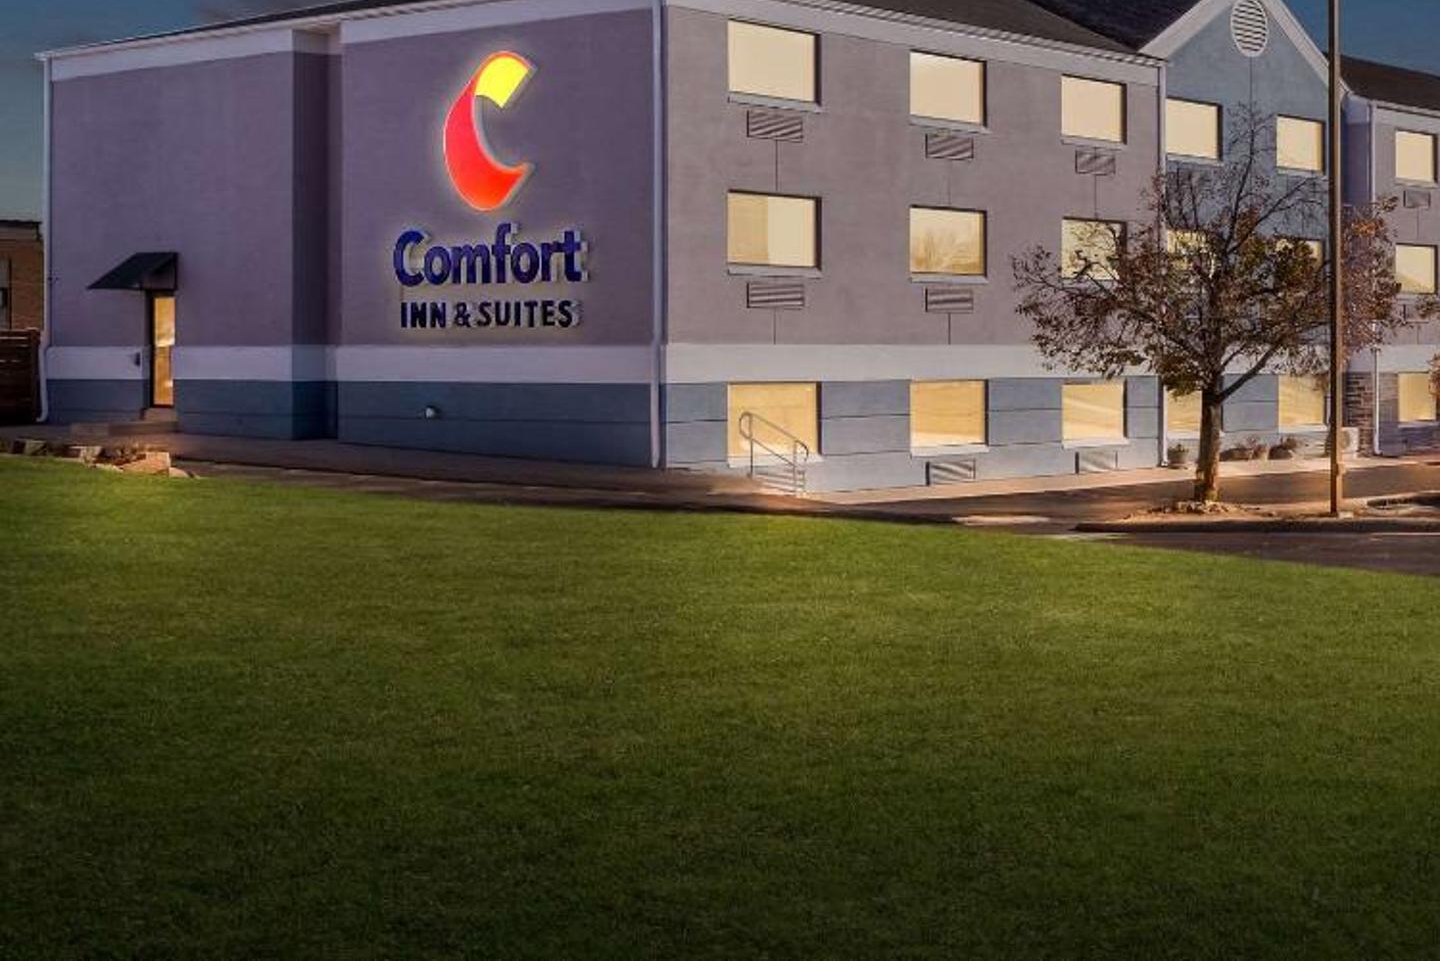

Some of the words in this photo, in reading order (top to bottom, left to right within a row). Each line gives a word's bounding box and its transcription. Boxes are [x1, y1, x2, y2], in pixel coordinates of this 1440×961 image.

[393, 222, 585, 287] Comfort
[400, 301, 447, 328] INN
[453, 301, 471, 327] &
[477, 299, 575, 328] SUITES
